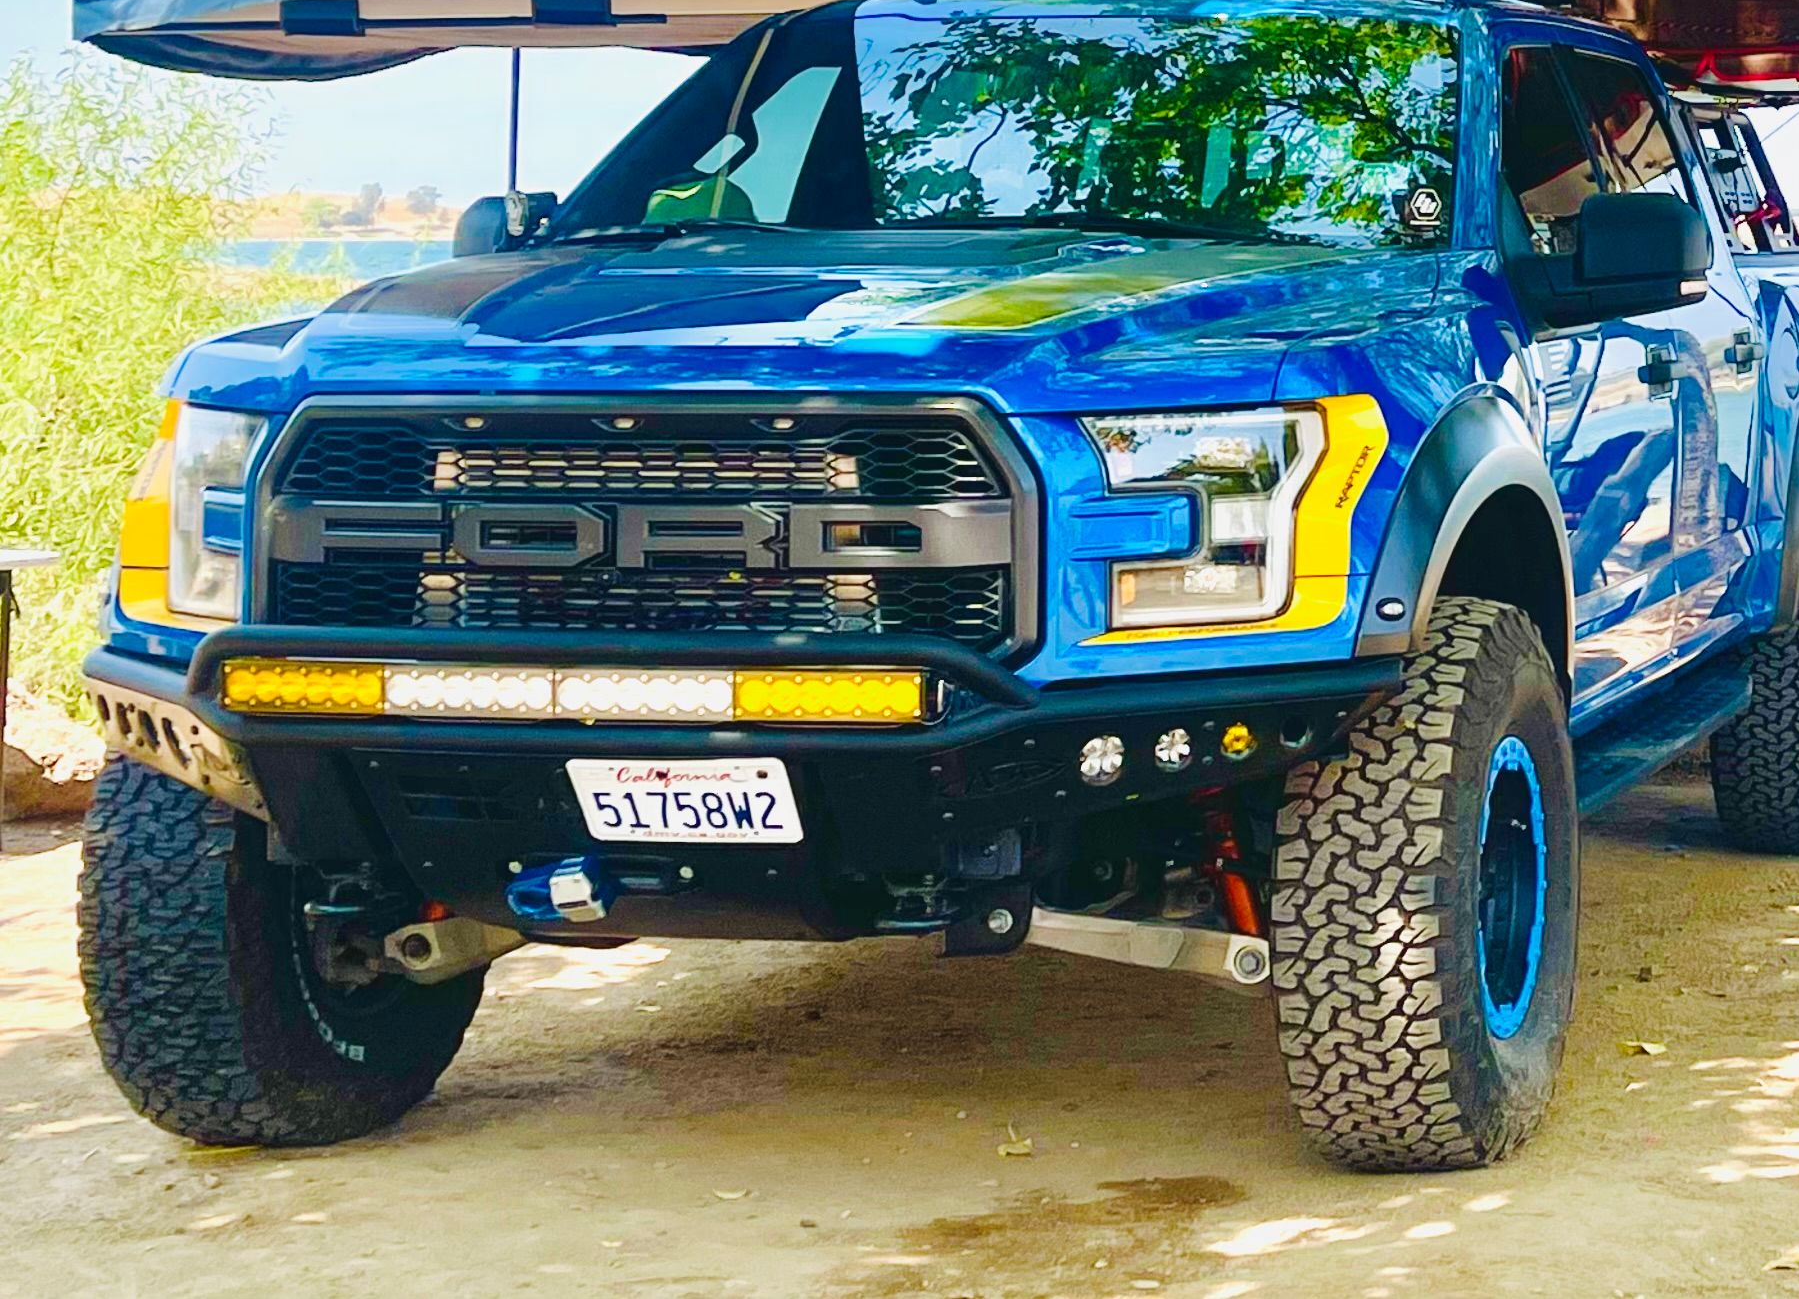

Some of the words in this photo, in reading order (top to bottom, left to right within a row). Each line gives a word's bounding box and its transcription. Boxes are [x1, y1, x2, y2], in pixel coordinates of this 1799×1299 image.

[272, 500, 1012, 569] FORD
[616, 767, 738, 788] Calfornia
[592, 791, 784, 829] 51758W2
